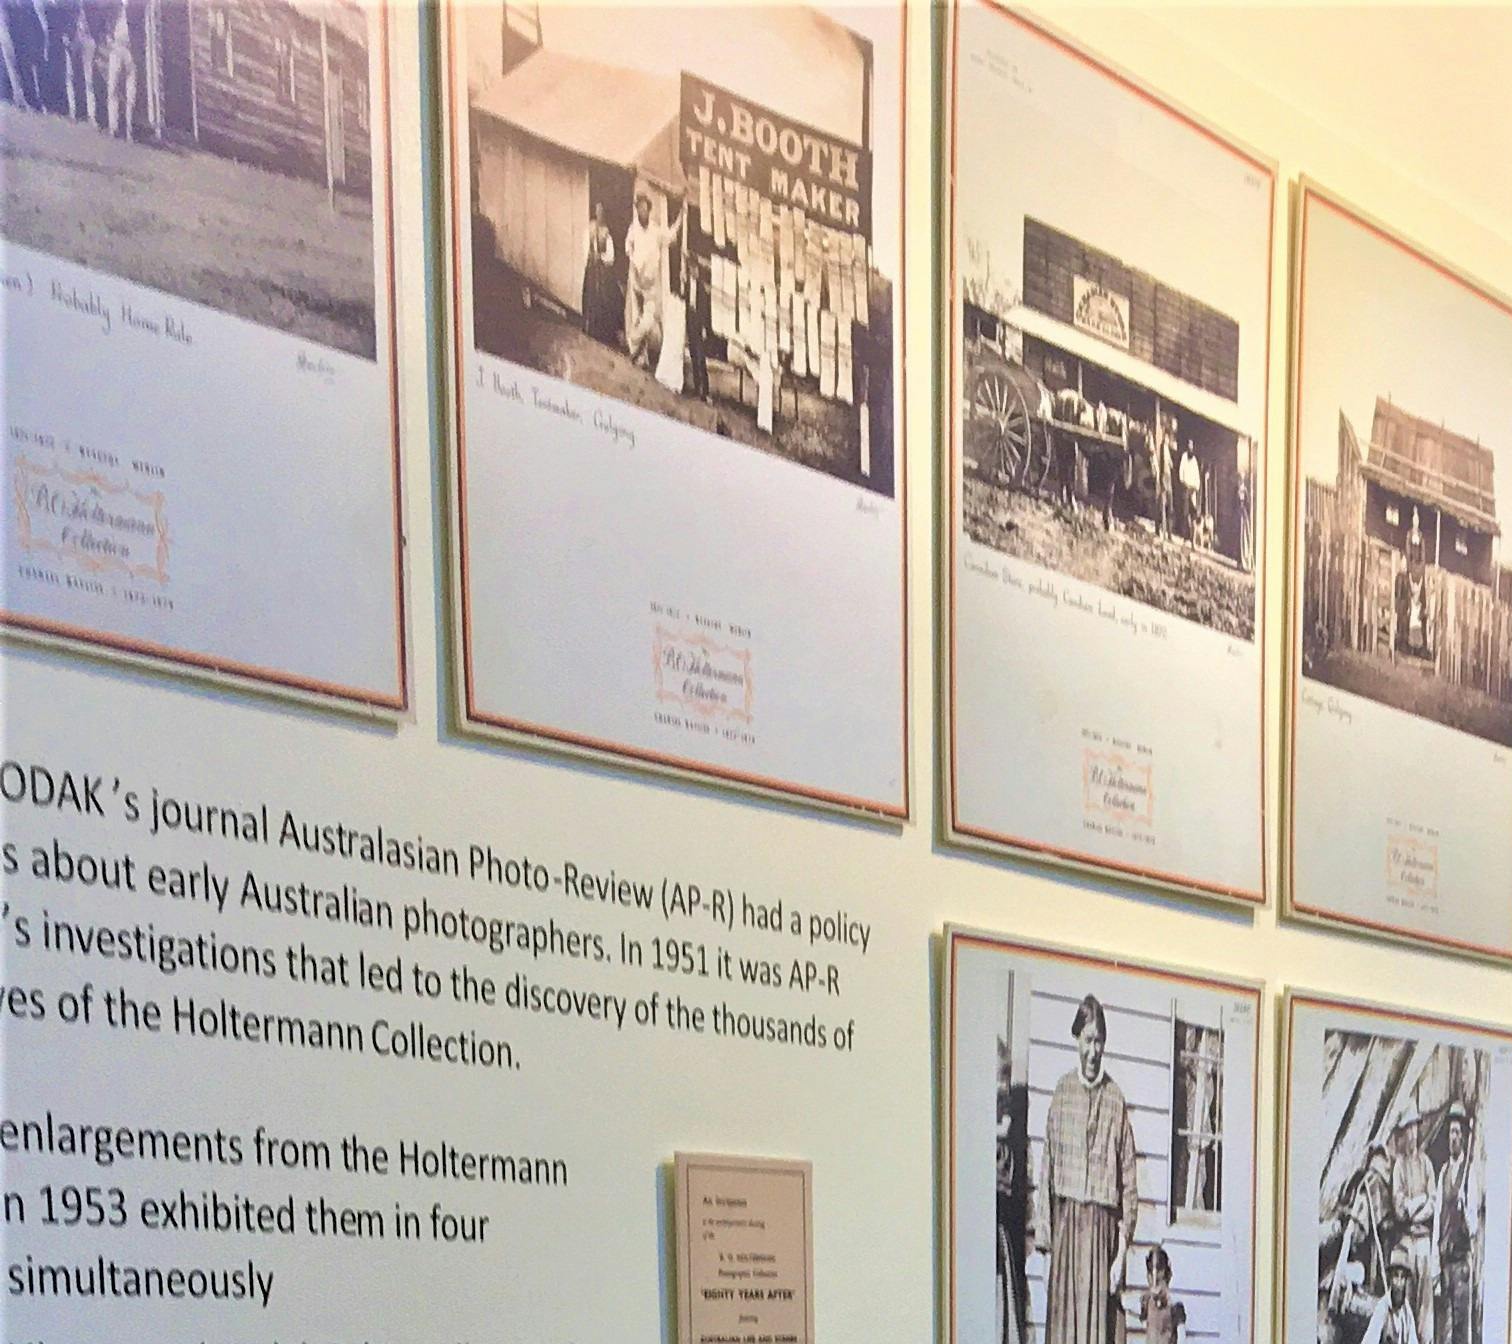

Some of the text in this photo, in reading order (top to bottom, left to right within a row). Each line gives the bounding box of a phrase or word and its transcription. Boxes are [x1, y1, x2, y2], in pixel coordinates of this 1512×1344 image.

[686, 127, 859, 227] TENT MAKER
[32, 839, 839, 995] about early Australian photographers. In 1951 it was AP-R
[151, 788, 267, 843] journal
[280, 811, 458, 876] Australasian
[470, 846, 653, 909] Photo-Review
[662, 878, 733, 930] (AP-R)
[743, 893, 782, 931] had
[791, 912, 801, 935] a
[810, 911, 870, 953] policy
[44, 910, 853, 1050] investigations that led to the discovery of the thousands of
[59, 984, 92, 1023] of
[104, 988, 160, 1030] the
[174, 996, 363, 1052] Holtermann
[372, 1020, 522, 1071] Collection.
[738, 1288, 765, 1300] YEARS
